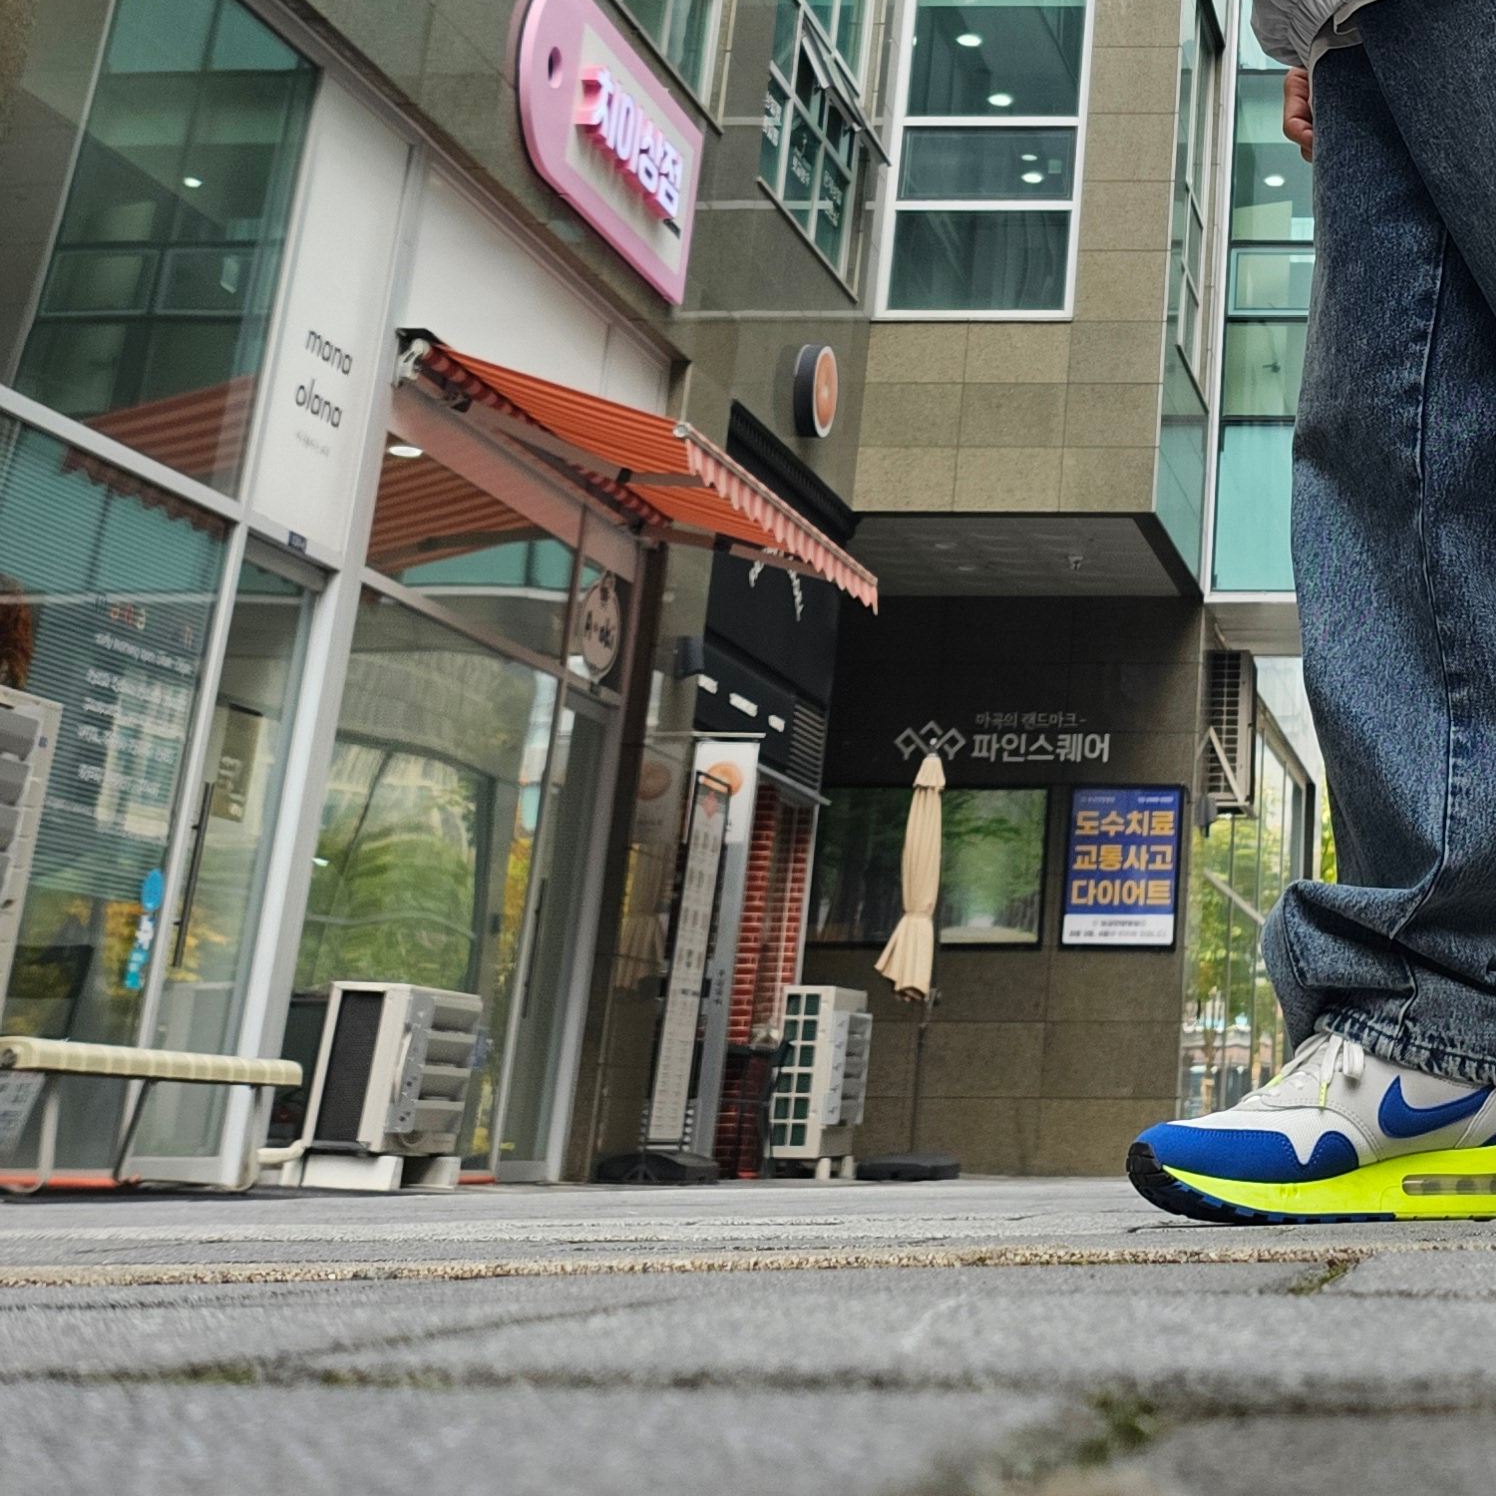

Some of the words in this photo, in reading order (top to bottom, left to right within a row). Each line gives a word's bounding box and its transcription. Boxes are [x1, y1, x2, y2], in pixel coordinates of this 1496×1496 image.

[306, 330, 353, 376] mana
[295, 378, 342, 428] olana
[975, 711, 1018, 729] 마곡의
[970, 732, 1112, 764] 파인스퀘어
[1074, 810, 1176, 837] 도수치료
[1072, 844, 1174, 871] 교통사고
[1070, 879, 1172, 906] 다이어트
